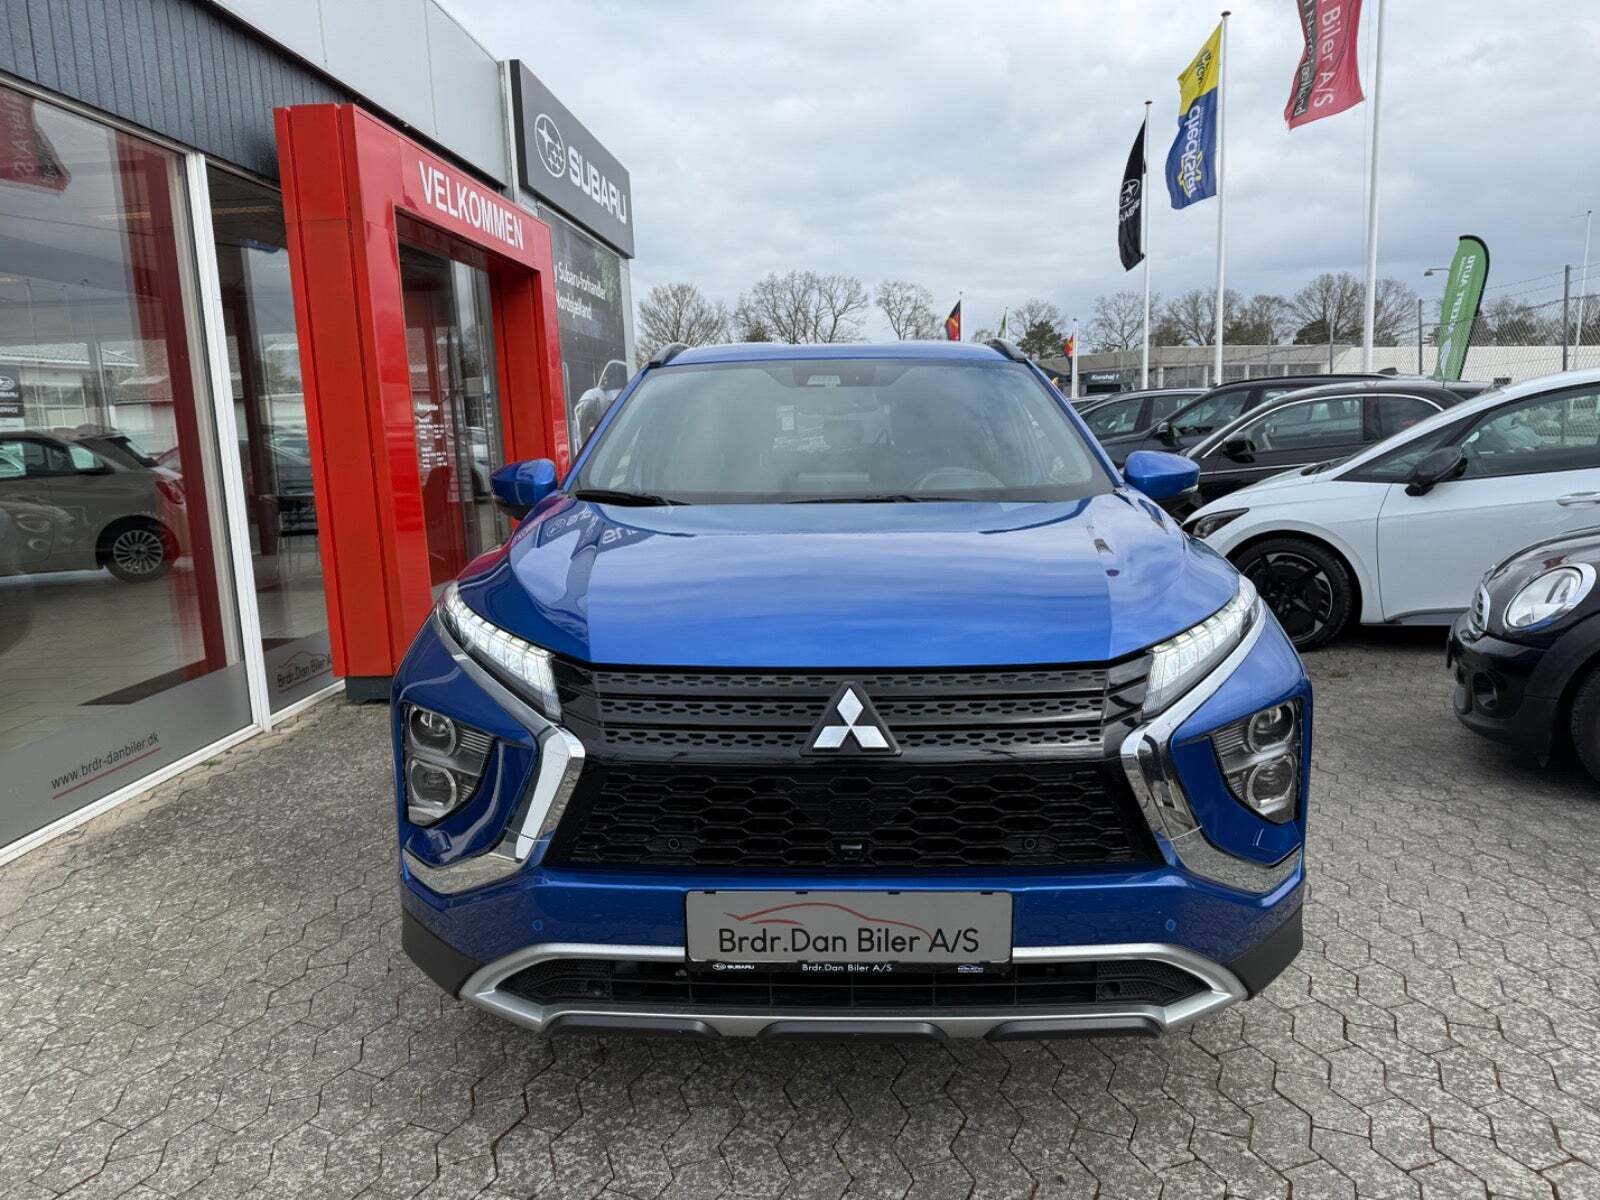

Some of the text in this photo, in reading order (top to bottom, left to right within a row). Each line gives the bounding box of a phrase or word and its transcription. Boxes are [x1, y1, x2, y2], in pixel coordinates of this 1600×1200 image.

[1313, 7, 1341, 108] Biler A/S
[419, 160, 524, 250] VELKOMMEN
[568, 146, 627, 225] SUBARU
[50, 732, 160, 789] www.brdr-danbiler.dk
[719, 928, 980, 953] Brdr.Dan Biler A/S
[802, 963, 893, 972] Brdr.Dan Biler A/S
